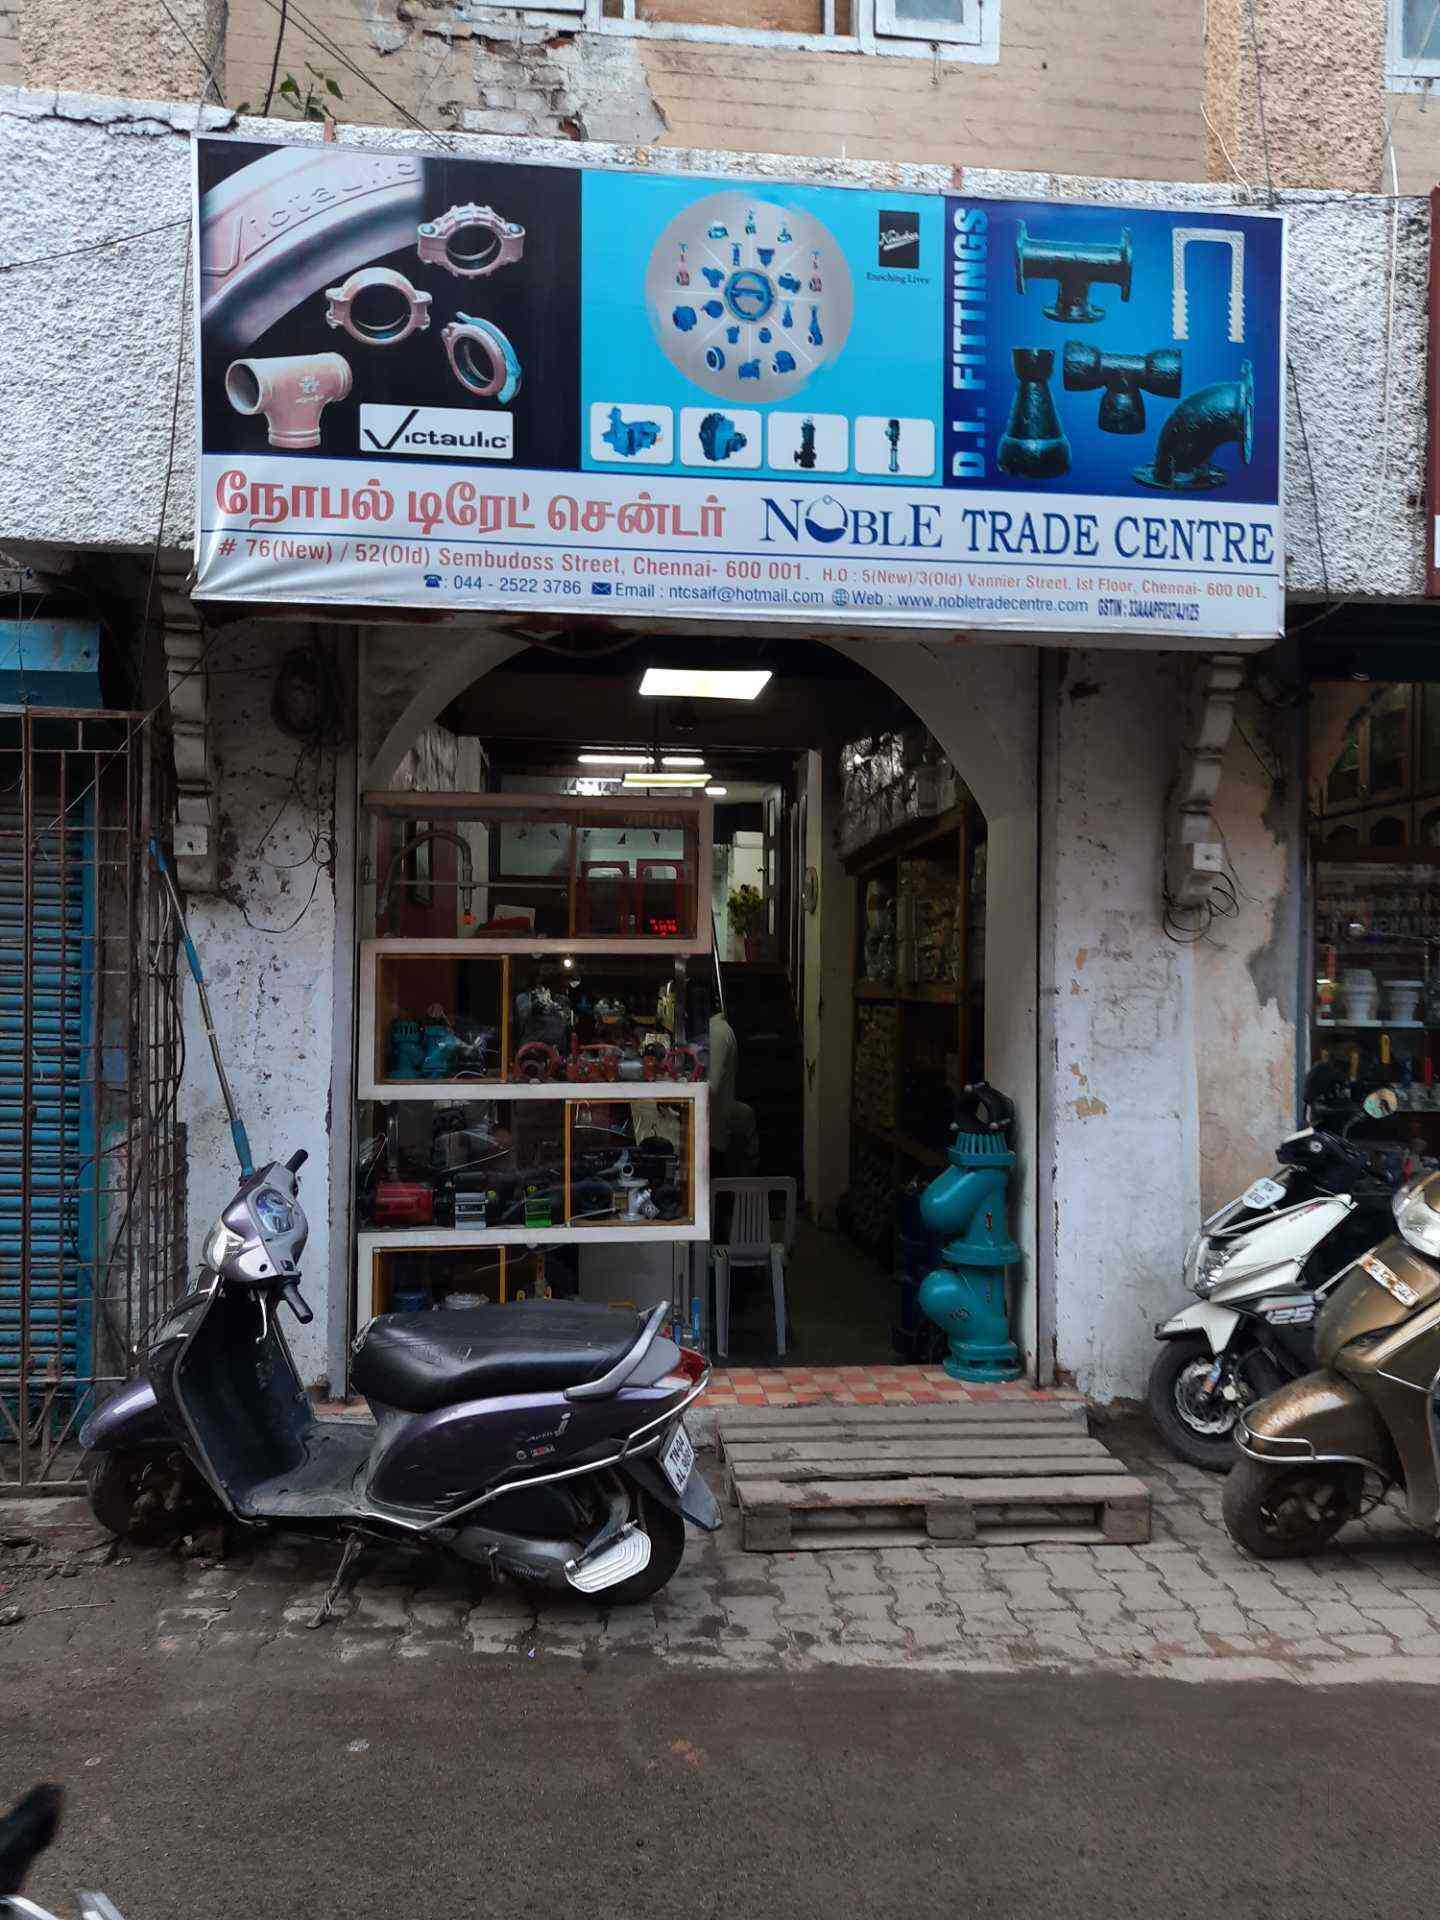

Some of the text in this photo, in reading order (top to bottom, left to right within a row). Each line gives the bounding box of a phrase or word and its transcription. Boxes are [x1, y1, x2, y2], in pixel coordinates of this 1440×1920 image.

[952, 207, 989, 477] D.I. FITTINGS
[363, 409, 508, 450] Victaulic
[216, 470, 726, 538] நோபல் டிரேட் சென்டர்
[760, 494, 1274, 565] NOBLE TRADE CENTRE
[218, 539, 237, 557] #
[246, 539, 333, 564] 76(New)
[355, 543, 430, 567] 52(Old)
[439, 547, 553, 571] Sembudoss
[726, 561, 761, 580] 600
[453, 575, 482, 590] 044
[500, 577, 538, 593] 2522
[543, 579, 582, 595] 3786
[615, 582, 655, 598] Email
[668, 585, 824, 606] ntcsaif@hotmail.com
[852, 590, 884, 605] Web
[897, 593, 1088, 613] www.nobletradecentre.com
